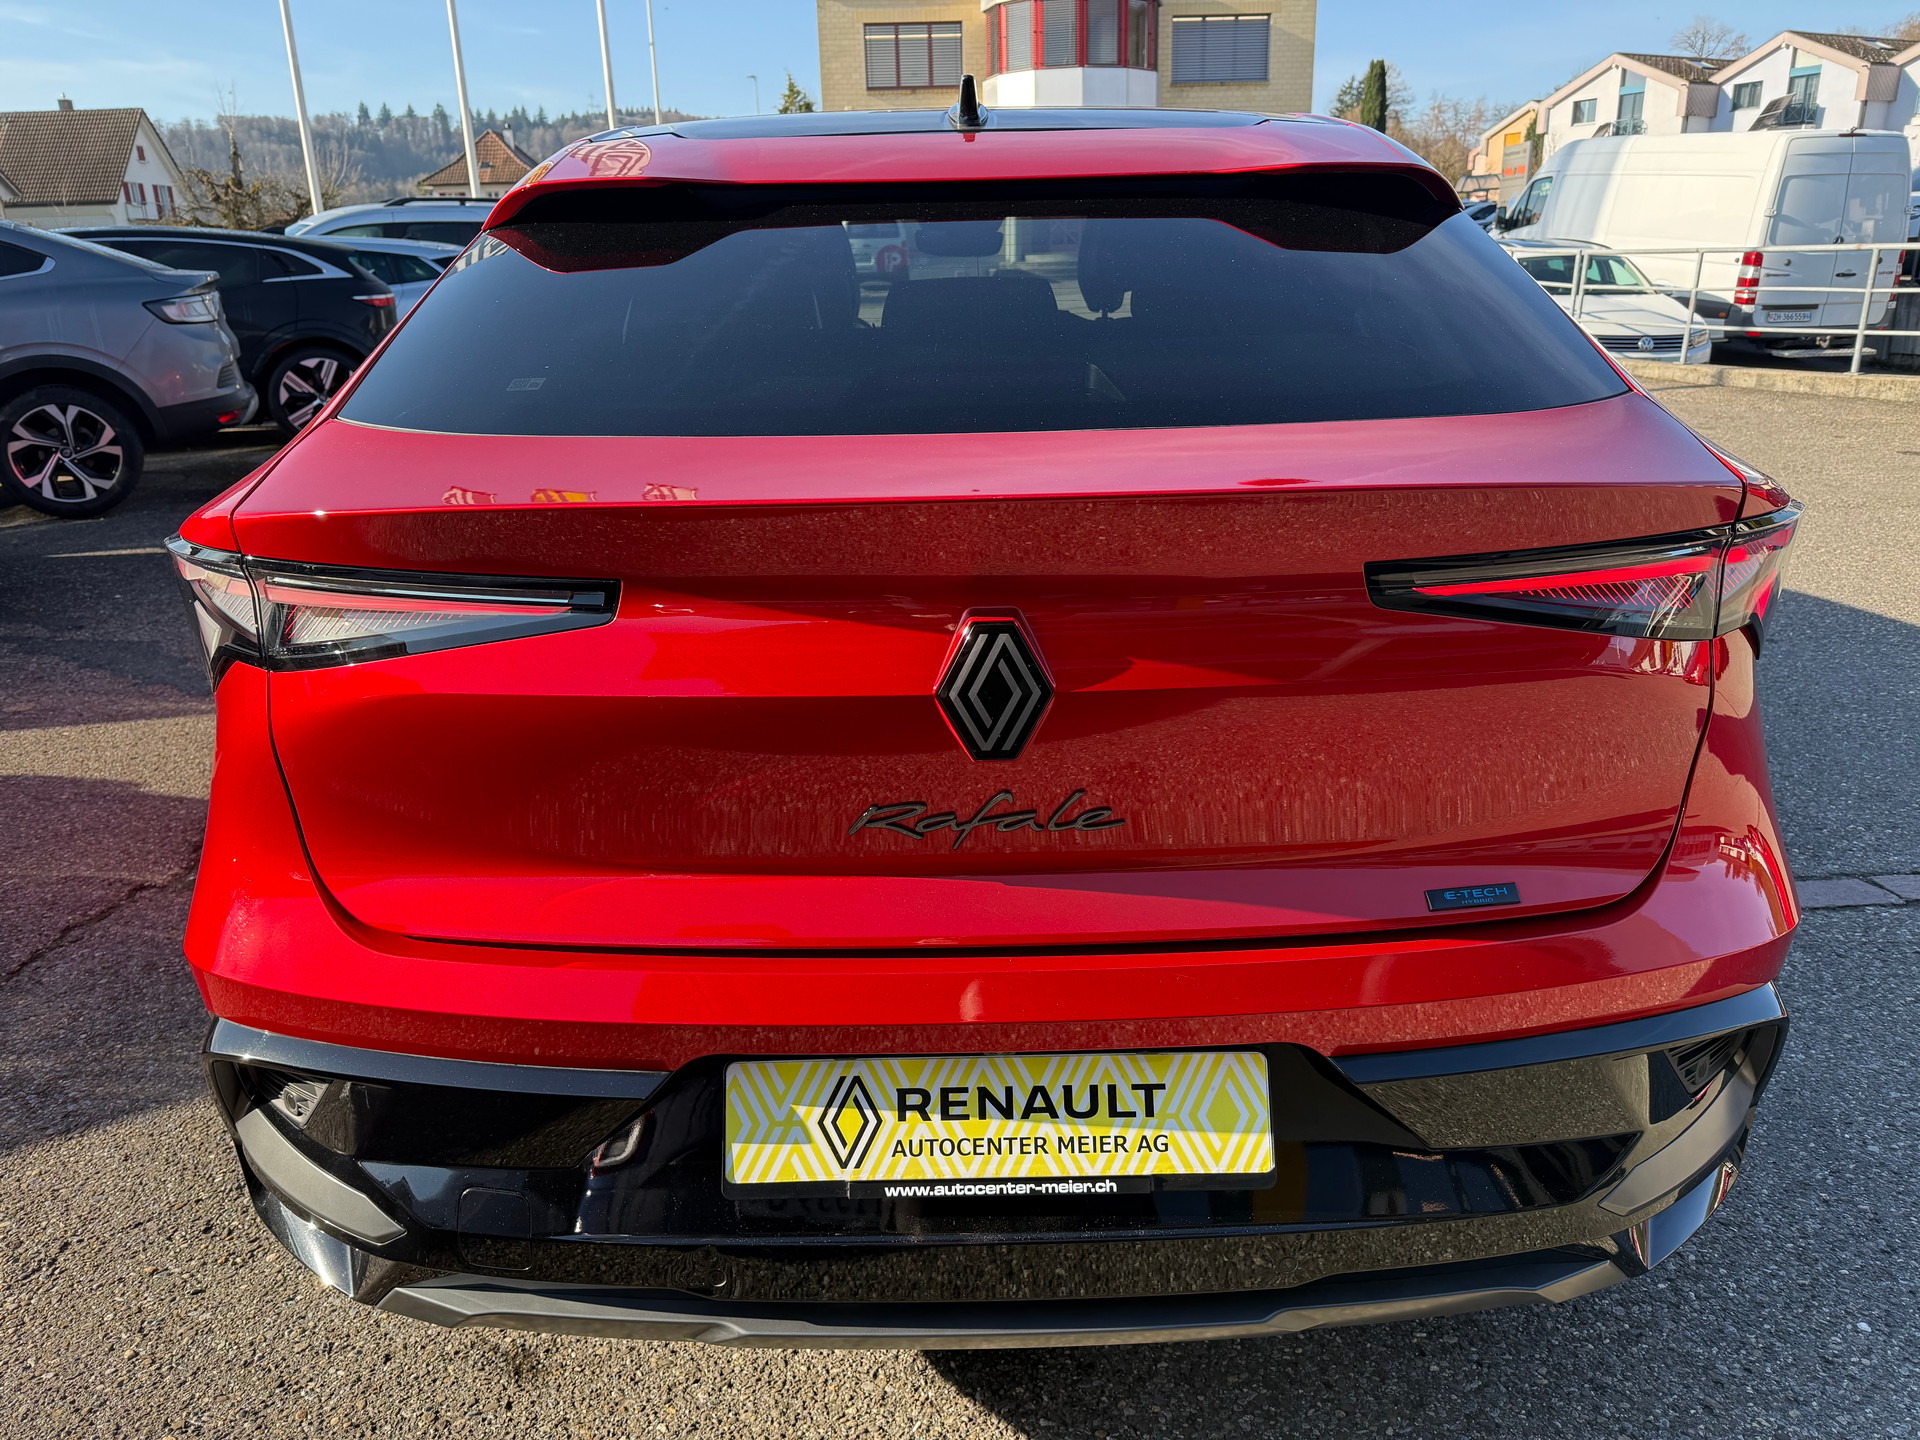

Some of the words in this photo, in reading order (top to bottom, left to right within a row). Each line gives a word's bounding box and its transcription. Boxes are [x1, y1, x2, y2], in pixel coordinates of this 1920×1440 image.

[848, 788, 1126, 850] Rafale
[1443, 886, 1508, 900] E-TECH
[1461, 897, 1494, 905] HYBRID
[896, 1083, 1166, 1122] RENAULT
[891, 1137, 1049, 1158] AUTOCENTER
[1057, 1135, 1130, 1154] MEIER
[1136, 1134, 1169, 1153] AG
[884, 1179, 1117, 1197] www.autocenter-meier.ch
